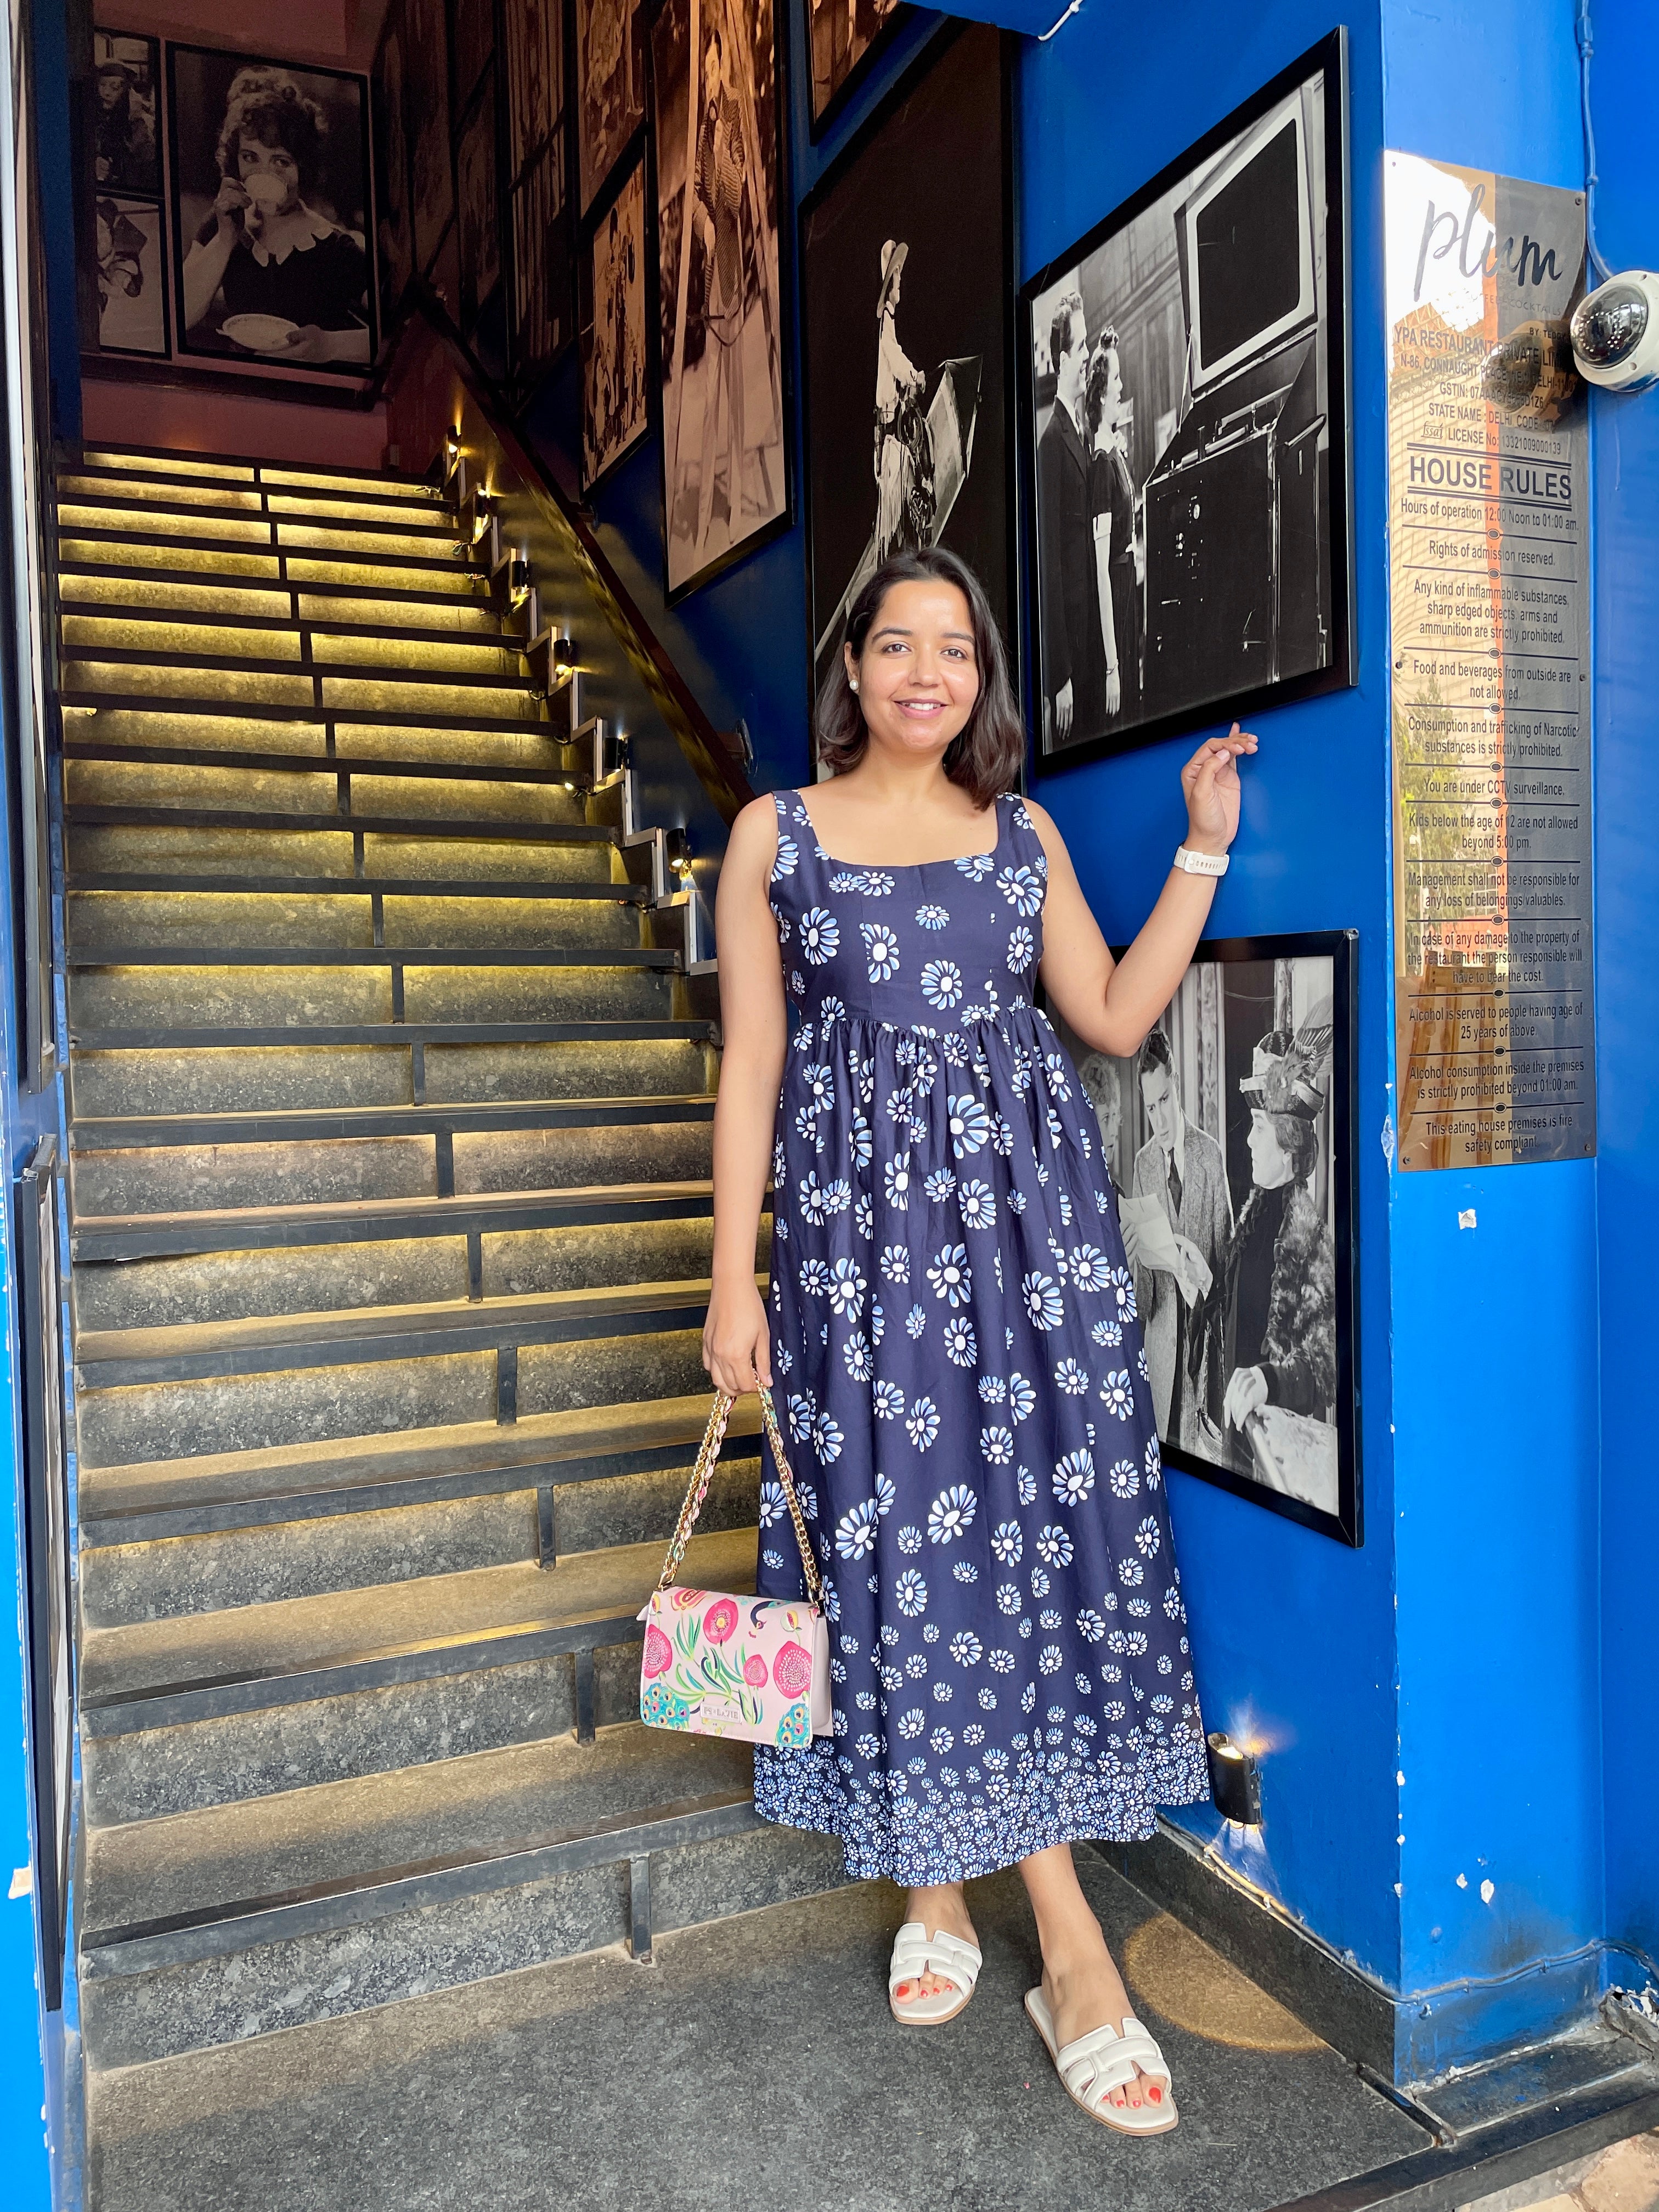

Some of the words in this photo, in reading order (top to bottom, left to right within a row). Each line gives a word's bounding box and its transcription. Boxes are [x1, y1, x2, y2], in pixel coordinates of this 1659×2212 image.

[1414, 184, 1562, 302] plum
[1510, 299, 1562, 316] COCKTAILS
[1395, 326, 1417, 346] YPA
[1420, 330, 1494, 356] RESTAURANT
[1498, 342, 1539, 364] PRIVATE
[1424, 357, 1478, 376] CONNAUGHT
[1441, 382, 1468, 398] GSTIN:
[1429, 403, 1455, 418] STATE
[1458, 405, 1481, 422] NAME
[1421, 421, 1443, 440] fssai
[1448, 428, 1483, 444] LICENSE
[1486, 433, 1499, 446] No:
[1410, 456, 1492, 490] HOUSE
[1501, 466, 1572, 499] RULES
[1401, 498, 1427, 515] Hours
[1430, 501, 1440, 515] of
[1442, 503, 1481, 520] operation
[1485, 507, 1505, 522] 12:00
[1509, 510, 1530, 524] Noon
[1533, 513, 1540, 525] to
[1543, 514, 1562, 528] 01:00
[1430, 540, 1457, 559] Rights
[1461, 544, 1470, 557] of
[1472, 545, 1515, 562] admission
[1518, 551, 1555, 566] reserved.
[1414, 579, 1431, 597] Any
[1435, 581, 1453, 596] kind
[1457, 583, 1465, 596] of
[1468, 583, 1519, 601] inflammable
[1427, 601, 1453, 619] sharp
[1456, 603, 1481, 620] edged
[1520, 612, 1540, 622] arms
[1543, 611, 1558, 624] and
[1420, 622, 1471, 637] ammunition
[1475, 628, 1488, 638] are
[1491, 626, 1520, 644] strictly
[1522, 630, 1564, 644] prohibited.
[1414, 660, 1436, 675] Food
[1440, 662, 1455, 676] and
[1458, 662, 1502, 680] beverages
[1505, 665, 1524, 679] from
[1527, 667, 1556, 682] outside
[1559, 672, 1571, 683] are
[1470, 686, 1483, 698] not
[1487, 686, 1521, 700] allowed.
[1409, 716, 1468, 734] Consumption
[1471, 719, 1487, 733] and
[1489, 720, 1531, 737] trafficking
[1534, 723, 1542, 736] of
[1425, 740, 1475, 754] substances
[1479, 740, 1485, 754] is
[1488, 741, 1516, 758] strictly
[1424, 778, 1440, 793] You
[1443, 782, 1457, 793] are
[1460, 780, 1485, 794] under
[1488, 780, 1511, 794] CCTV
[1514, 781, 1565, 795] surveillance.
[1409, 812, 1429, 827] Kids
[1432, 813, 1458, 828] below
[1461, 814, 1474, 828] the
[1477, 817, 1492, 831] age
[1495, 814, 1503, 828] of
[1506, 815, 1515, 828] 12
[1517, 817, 1530, 828] are
[1533, 816, 1545, 828] not
[1548, 816, 1578, 829] allowed
[1462, 835, 1494, 851] beyond
[1497, 836, 1514, 849] 5:00
[1409, 872, 1465, 889] Management
[1468, 872, 1488, 886] shall
[1492, 873, 1505, 886] not
[1508, 872, 1516, 886] be
[1520, 873, 1566, 889] responsible
[1569, 872, 1579, 886] for
[1426, 896, 1440, 910] any
[1444, 894, 1462, 907] loss
[1465, 894, 1474, 907] of
[1410, 933, 1418, 945] In
[1421, 935, 1442, 945] case
[1446, 931, 1453, 945] of
[1457, 934, 1471, 948] any
[1475, 931, 1508, 948] damage
[1511, 932, 1518, 944] to
[1521, 931, 1533, 943] the
[1536, 931, 1570, 947] property
[1572, 929, 1579, 943] of
[1408, 952, 1421, 966] the
[1425, 953, 1471, 966] restaurant
[1473, 951, 1486, 964] the
[1488, 953, 1517, 967] person
[1520, 950, 1566, 964] responsible
[1570, 949, 1582, 962] will
[1453, 970, 1474, 984] have
[1476, 972, 1484, 983] to
[1509, 969, 1521, 982] the
[1523, 969, 1543, 982] cost.
[1409, 1007, 1443, 1021] Alcohol
[1446, 1007, 1453, 1020] is
[1457, 1006, 1485, 1020] served
[1488, 1006, 1496, 1018] to
[1499, 1005, 1527, 1024] people
[1529, 1003, 1556, 1019] having
[1559, 1005, 1572, 1017] age
[1575, 1002, 1583, 1016] of
[1461, 1026, 1471, 1039] 25
[1474, 1025, 1497, 1042] years
[1499, 1024, 1508, 1036] of
[1410, 1065, 1443, 1080] Alcohol
[1447, 1064, 1503, 1079] consumption
[1505, 1062, 1530, 1075] inside
[1533, 1061, 1545, 1074] the
[1548, 1060, 1584, 1076] premises
[1418, 1086, 1425, 1099] is
[1428, 1084, 1458, 1101] strictly
[1461, 1081, 1504, 1098] prohibited
[1507, 1080, 1537, 1096] beyond
[1540, 1079, 1561, 1092] 01:00
[1426, 1122, 1445, 1136] This
[1448, 1120, 1476, 1136] eating
[1479, 1118, 1505, 1132] house
[1508, 1115, 1547, 1132] premises
[1549, 1115, 1556, 1127] is
[1559, 1115, 1572, 1127] fire
[1465, 1139, 1492, 1154] safety
